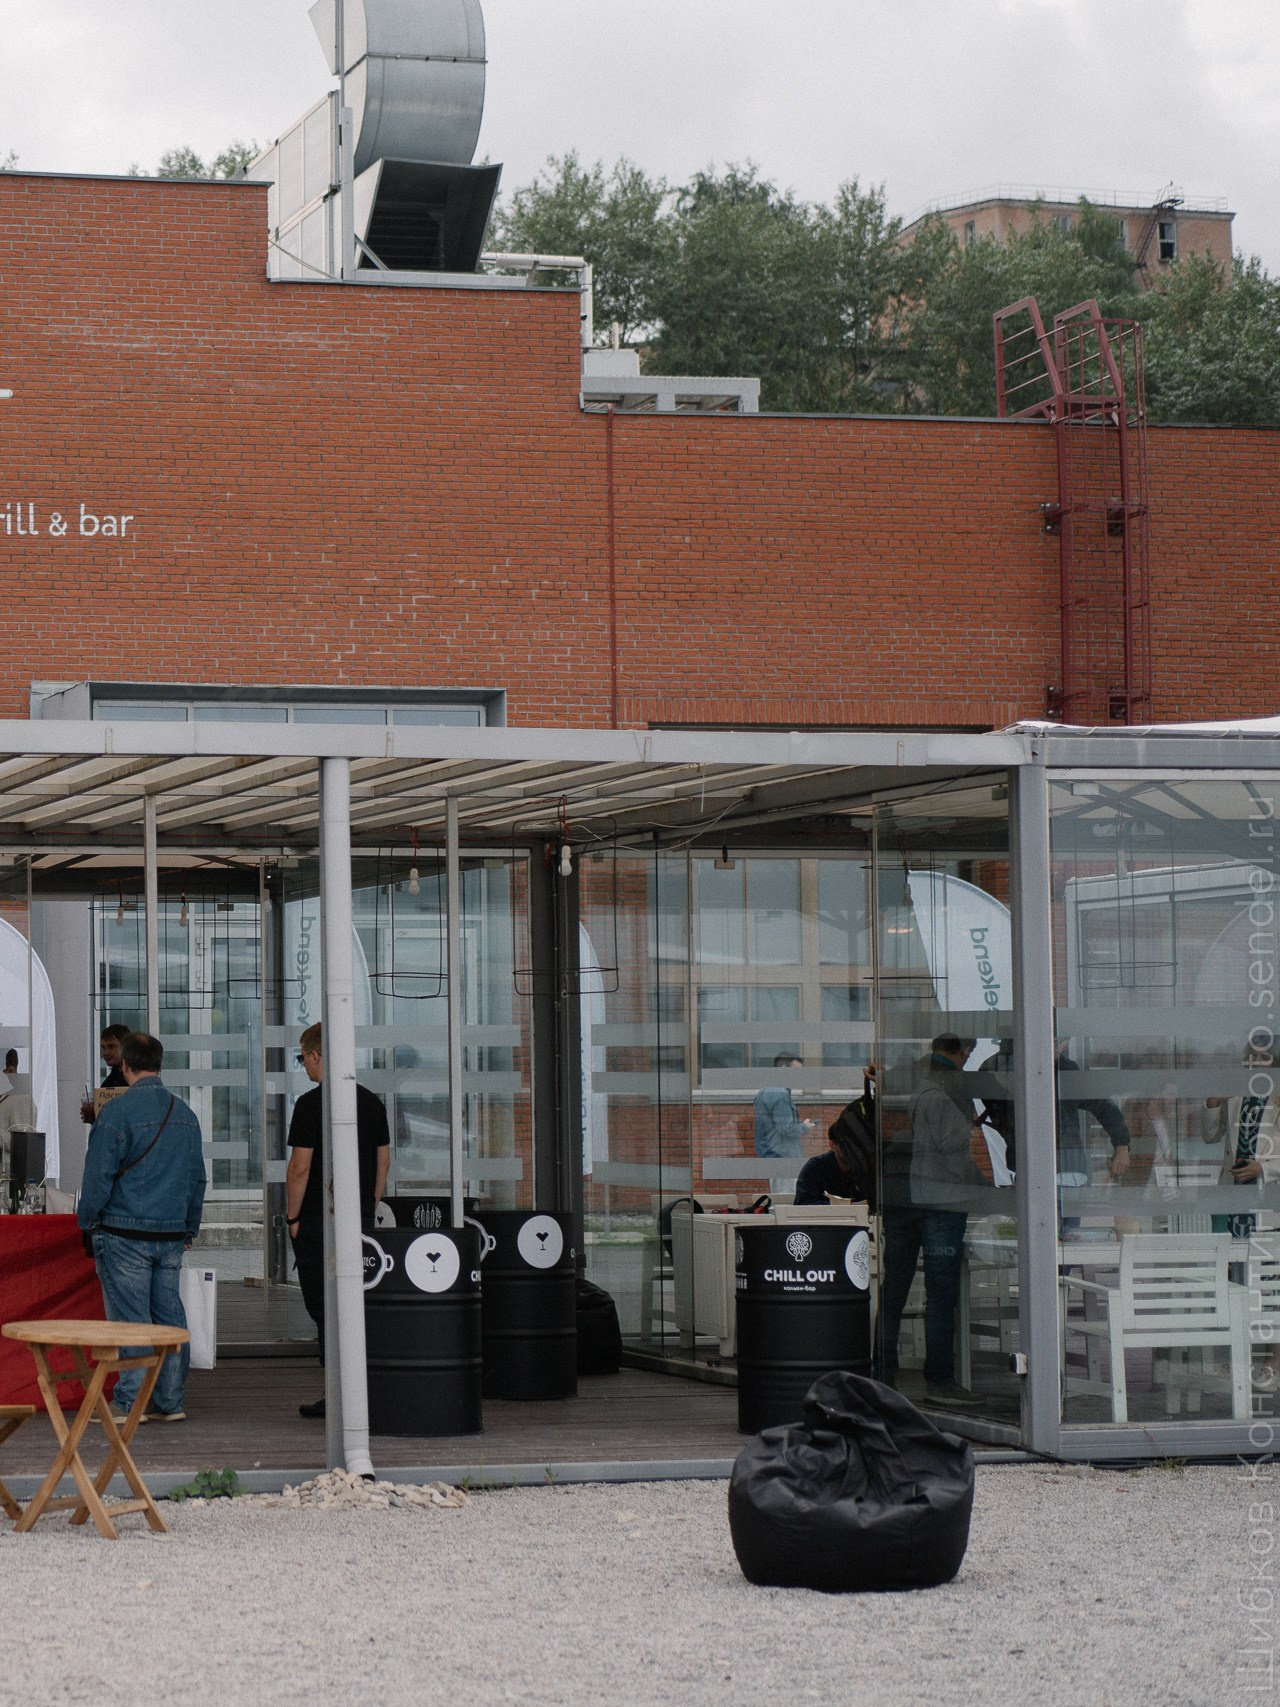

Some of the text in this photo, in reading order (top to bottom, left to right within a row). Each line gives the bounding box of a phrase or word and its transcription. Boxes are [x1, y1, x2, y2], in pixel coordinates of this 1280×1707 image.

[48, 513, 68, 537] &
[79, 504, 134, 537] bar
[763, 1269, 805, 1283] CHILL
[806, 1270, 836, 1283] OUT
